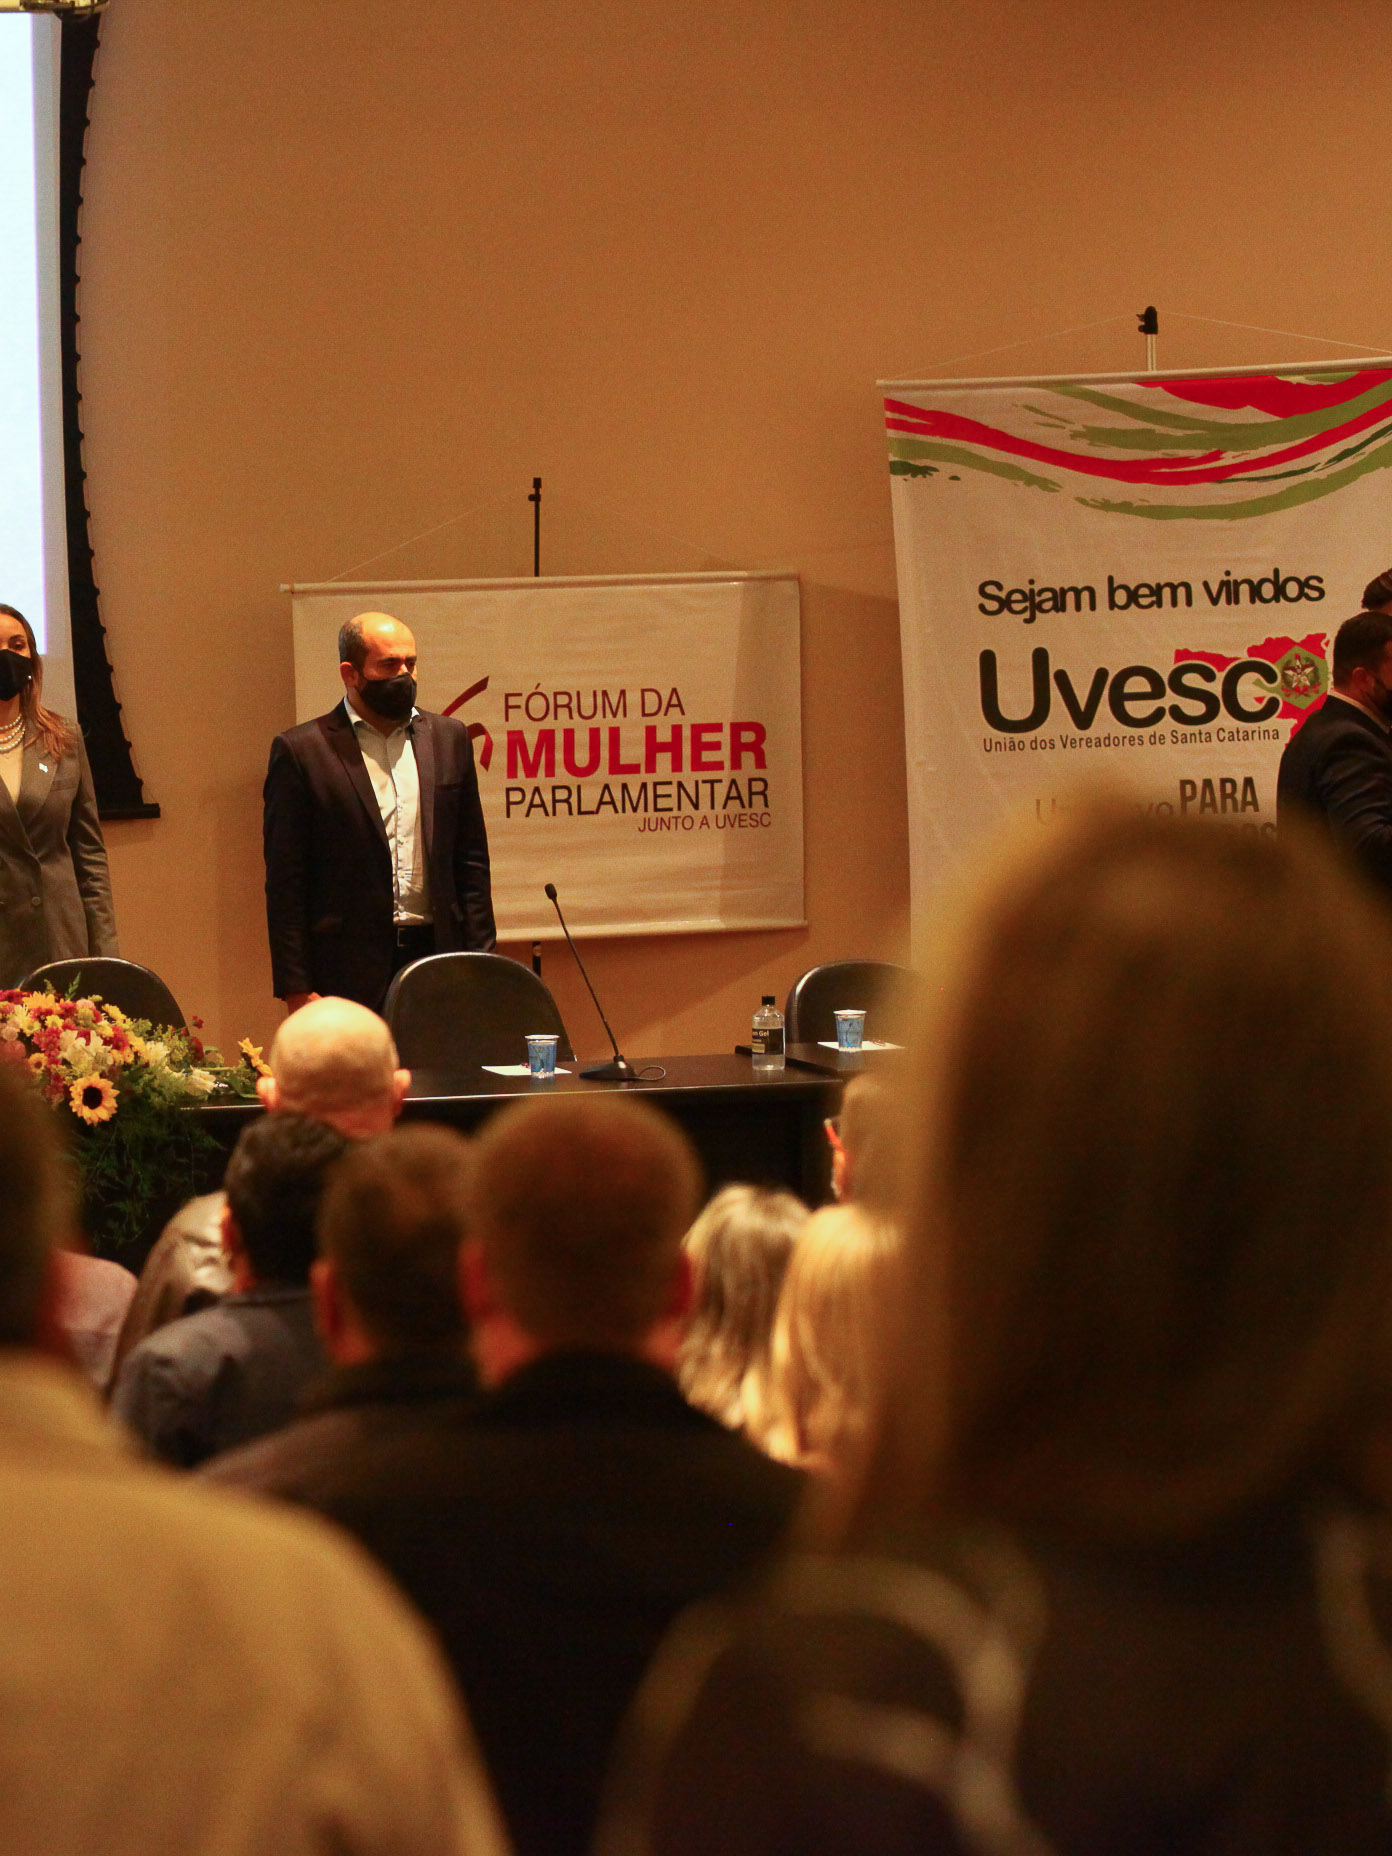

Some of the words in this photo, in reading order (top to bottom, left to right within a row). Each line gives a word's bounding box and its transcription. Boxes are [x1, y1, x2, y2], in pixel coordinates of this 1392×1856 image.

[977, 578, 1097, 624] Sejam
[1107, 575, 1193, 612] bem
[1202, 567, 1326, 607] vindos
[504, 683, 628, 723] FÓRUM
[639, 687, 686, 718] DA
[979, 646, 1282, 734] Uvesc
[506, 721, 768, 779] MULHER
[983, 736, 1026, 753] União
[1029, 735, 1056, 750] dos
[1060, 732, 1145, 749] Vereadores
[1148, 730, 1167, 746] de
[1170, 728, 1212, 745] Santa
[1216, 726, 1280, 743] Catarina
[505, 777, 770, 819] PARLAMENTAR
[1179, 775, 1260, 817] PARA
[638, 815, 695, 833] JUNTO
[699, 813, 711, 830] A
[715, 811, 772, 829] UVESC
